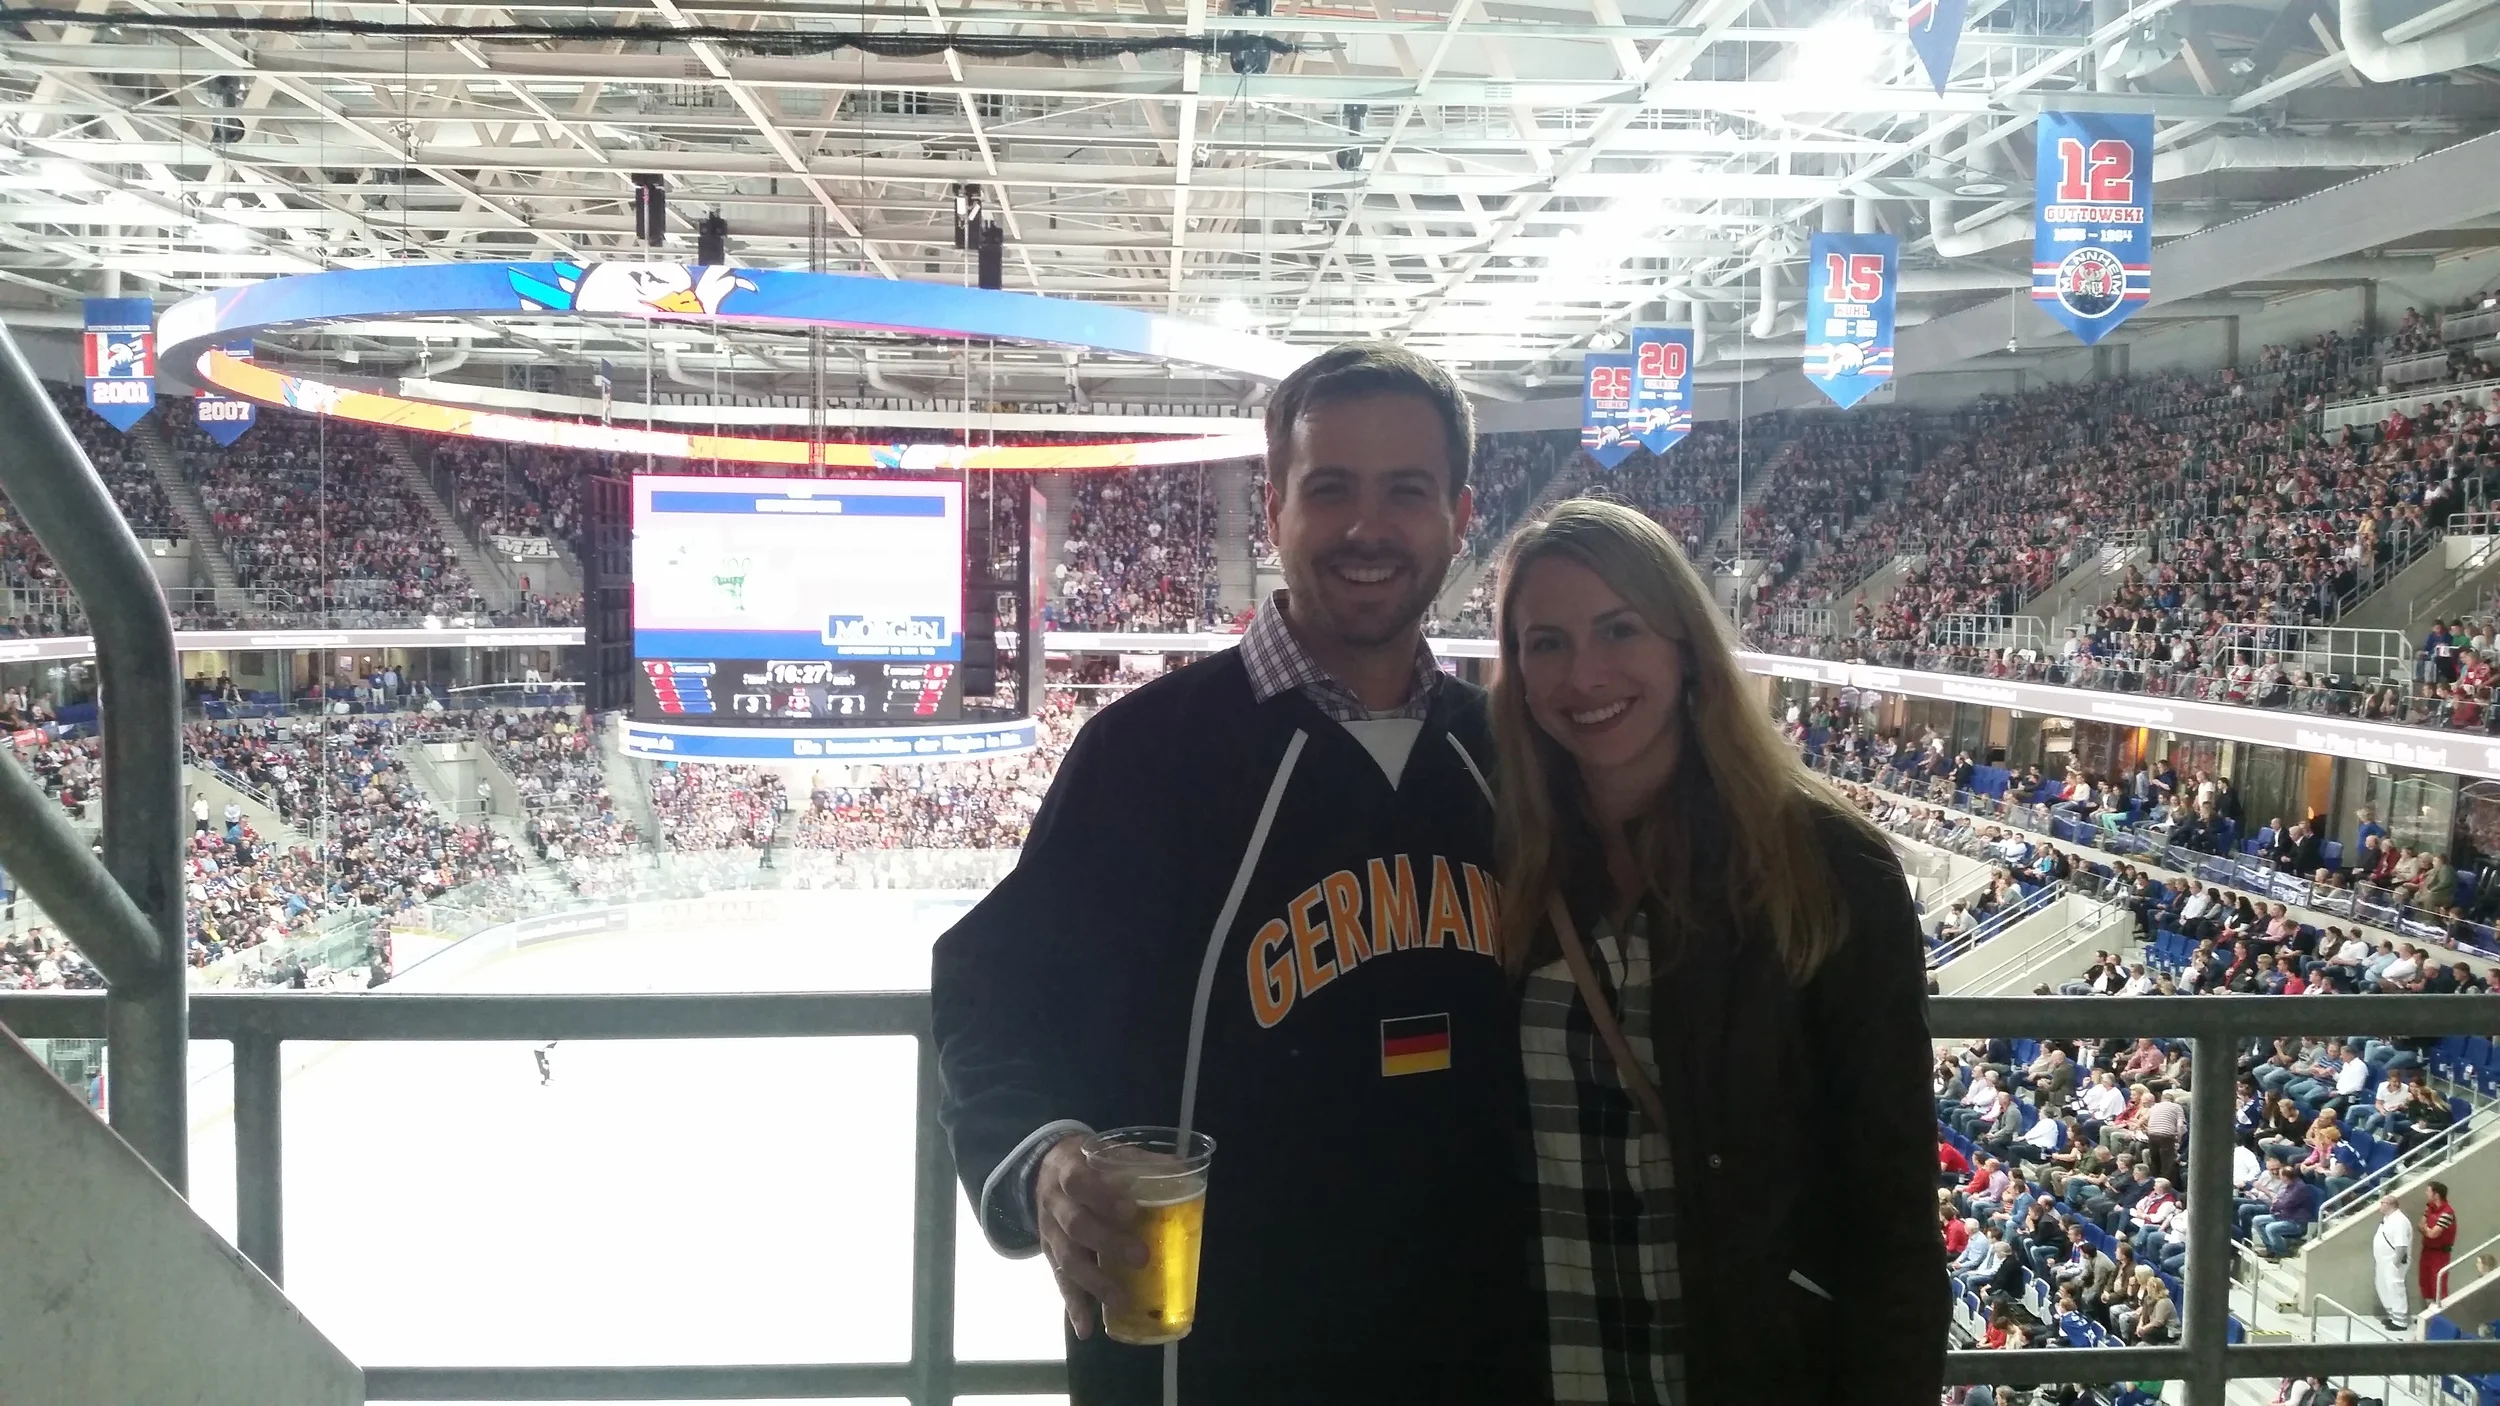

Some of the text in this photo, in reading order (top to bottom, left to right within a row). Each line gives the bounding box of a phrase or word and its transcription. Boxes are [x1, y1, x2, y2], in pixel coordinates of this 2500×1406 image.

[2057, 138, 2134, 203] 12
[2045, 205, 2144, 223] GUTTOWSKI
[1824, 253, 1884, 303] 15
[2060, 250, 2122, 295] MANNHEIM
[1638, 342, 1687, 379] 20
[93, 381, 149, 404] 2001
[1590, 367, 1632, 399] 25
[199, 402, 250, 421] 2007
[841, 696, 853, 715] 2
[1247, 854, 1505, 1029] GERMAN
